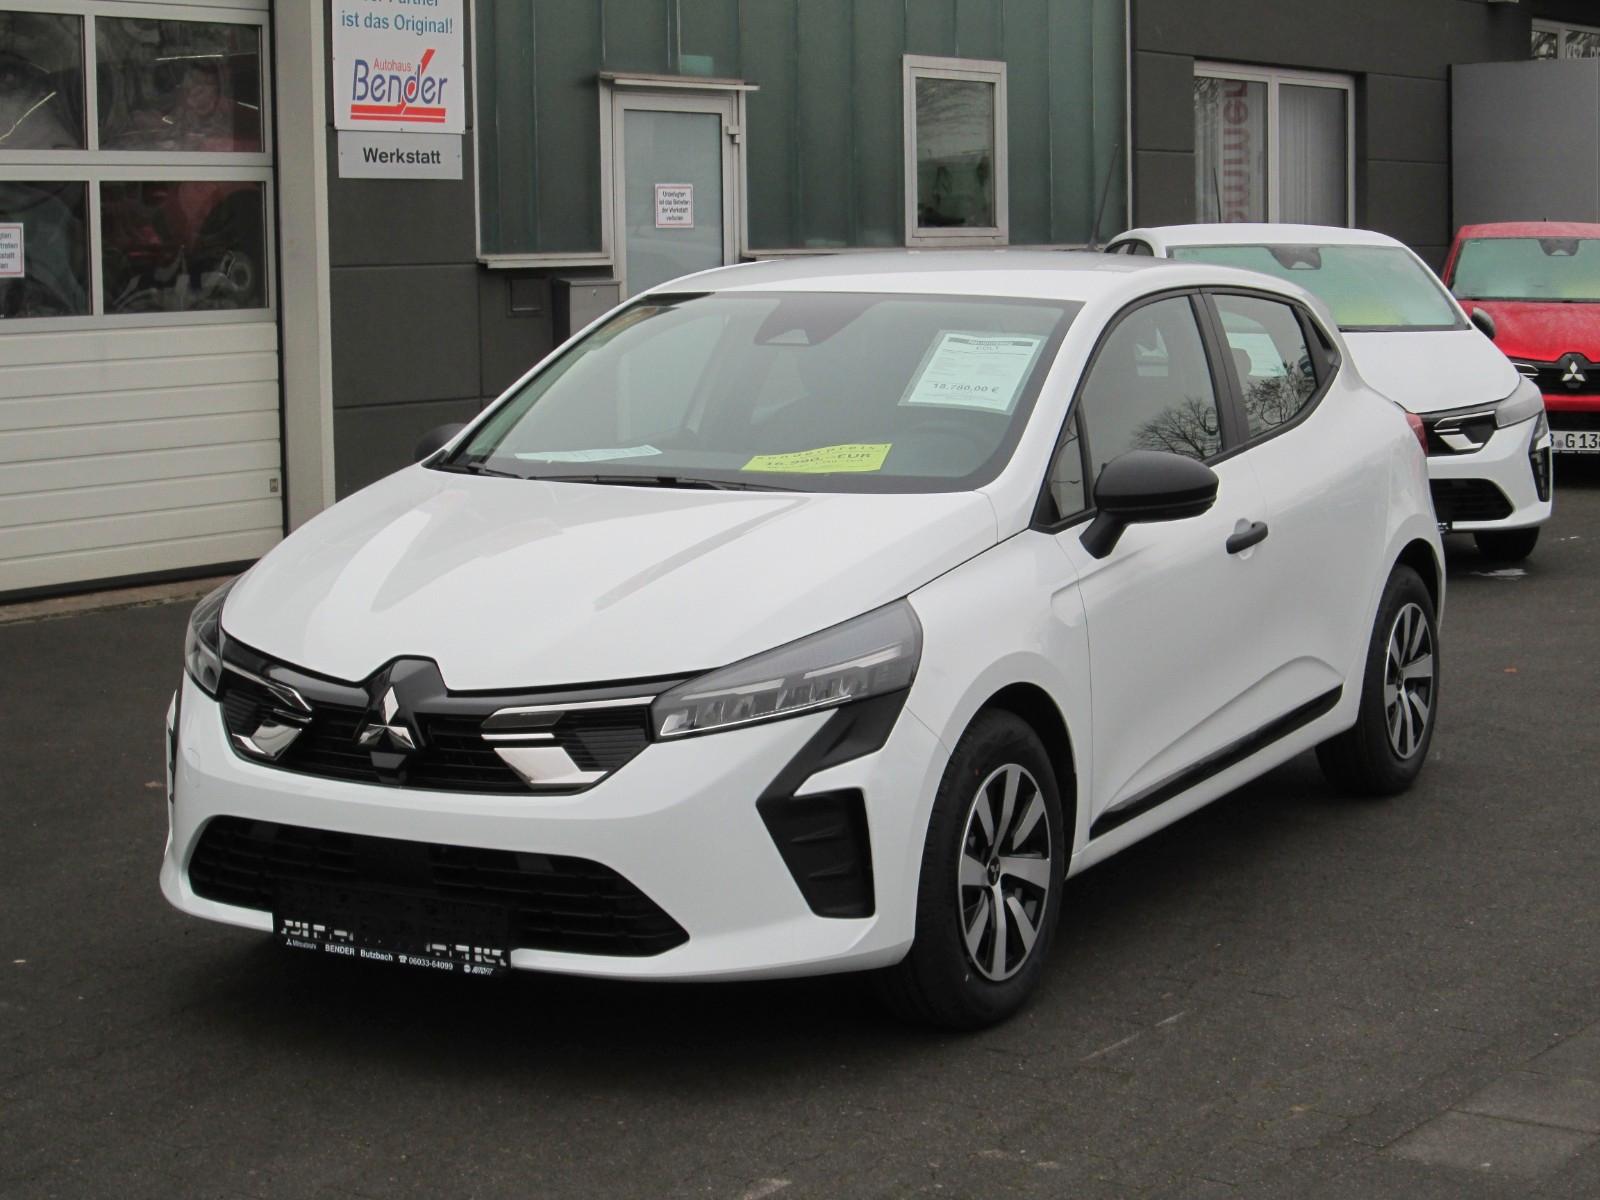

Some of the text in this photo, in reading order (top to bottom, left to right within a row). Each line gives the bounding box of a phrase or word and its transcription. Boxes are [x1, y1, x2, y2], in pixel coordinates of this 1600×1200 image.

[342, 10, 453, 36] ist das Original!
[373, 58, 411, 73] Autohaus
[352, 59, 448, 105] Bender
[363, 147, 441, 164] Werkstatt
[325, 944, 355, 956] BENDER
[360, 949, 393, 962] Butzbach
